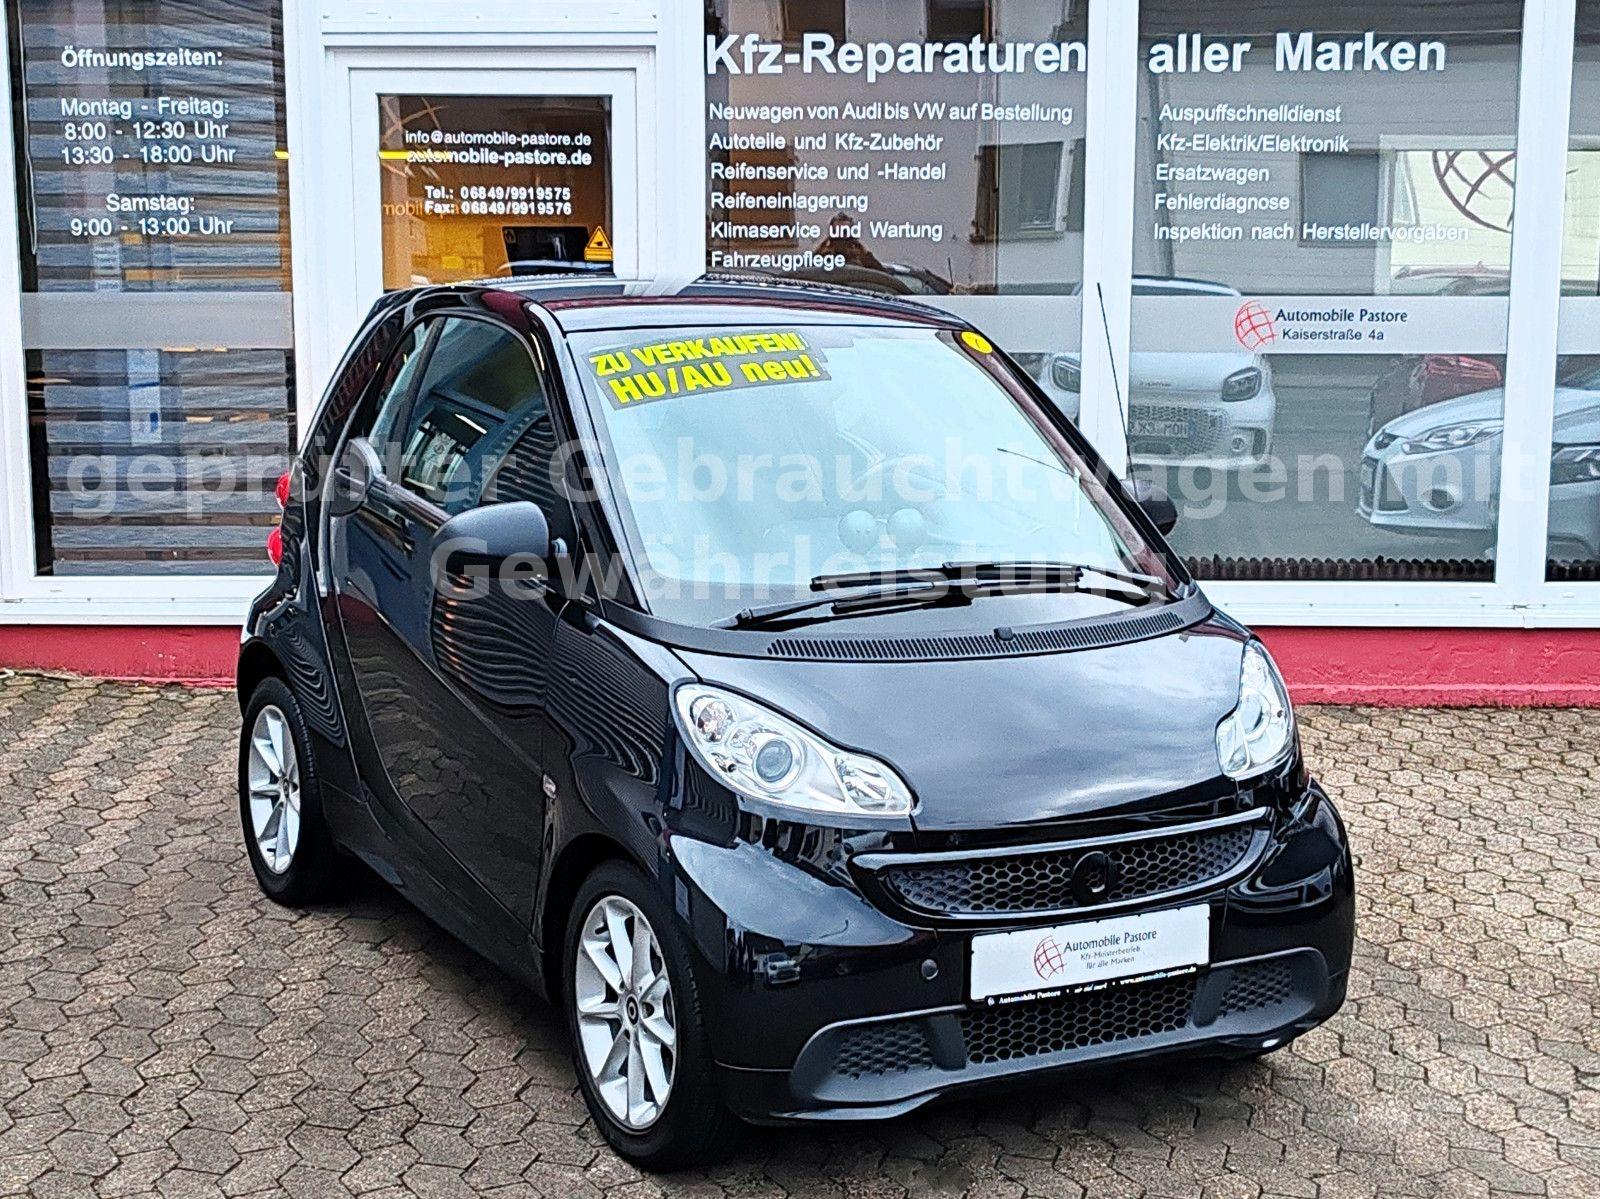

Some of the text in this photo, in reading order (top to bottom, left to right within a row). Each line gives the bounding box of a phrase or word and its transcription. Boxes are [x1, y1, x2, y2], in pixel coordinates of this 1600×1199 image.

[61, 46, 223, 70] Öffnungszeiten:
[706, 31, 1447, 83] Kfz-Reparaturen aller Marken
[61, 98, 132, 119] Montag
[158, 97, 229, 118] Freitag:
[709, 102, 1073, 125] Neuwagen von Audi bis VW auf Bestellung
[1158, 104, 1342, 124] Auspuffschnelldienst
[65, 122, 106, 140] 8:00
[133, 122, 185, 140] 12:30
[195, 121, 229, 139] Uhr
[405, 130, 592, 148] info@automobile-pastore.de
[709, 133, 943, 151] Autoteile und Kfz-Zubehör
[1157, 134, 1349, 153] Kfz-Elektrik/Elektronik
[61, 147, 114, 165] 13:30
[140, 146, 193, 163] 18:00
[202, 145, 236, 163] Uhr
[711, 163, 946, 180] Reifenservice und -Handel
[1156, 165, 1270, 185] Ersatzwagen
[425, 185, 454, 200] Tel.:
[711, 192, 869, 212] Reifeneinlagerung
[106, 194, 195, 215] Samstag:
[425, 201, 455, 214] Fax:
[1154, 194, 1291, 213] Fehlerdiagnose
[71, 218, 112, 236] 9:00
[139, 217, 190, 235] 13:00
[199, 217, 233, 234] Uhr
[711, 221, 943, 241] Klimaservice und Wartung
[1154, 223, 1469, 244] Inspektion nach Herstellervorgaben
[711, 251, 846, 271] Fahrzeugpflege
[1275, 307, 1408, 323] Automobile Pastore
[1282, 327, 1385, 342] Kaiserstraße 4a
[589, 332, 807, 377] ZU VERKAUFEN!
[608, 354, 821, 404] HU/AU neu!
[1064, 929, 1158, 953] Automobile Pastore
